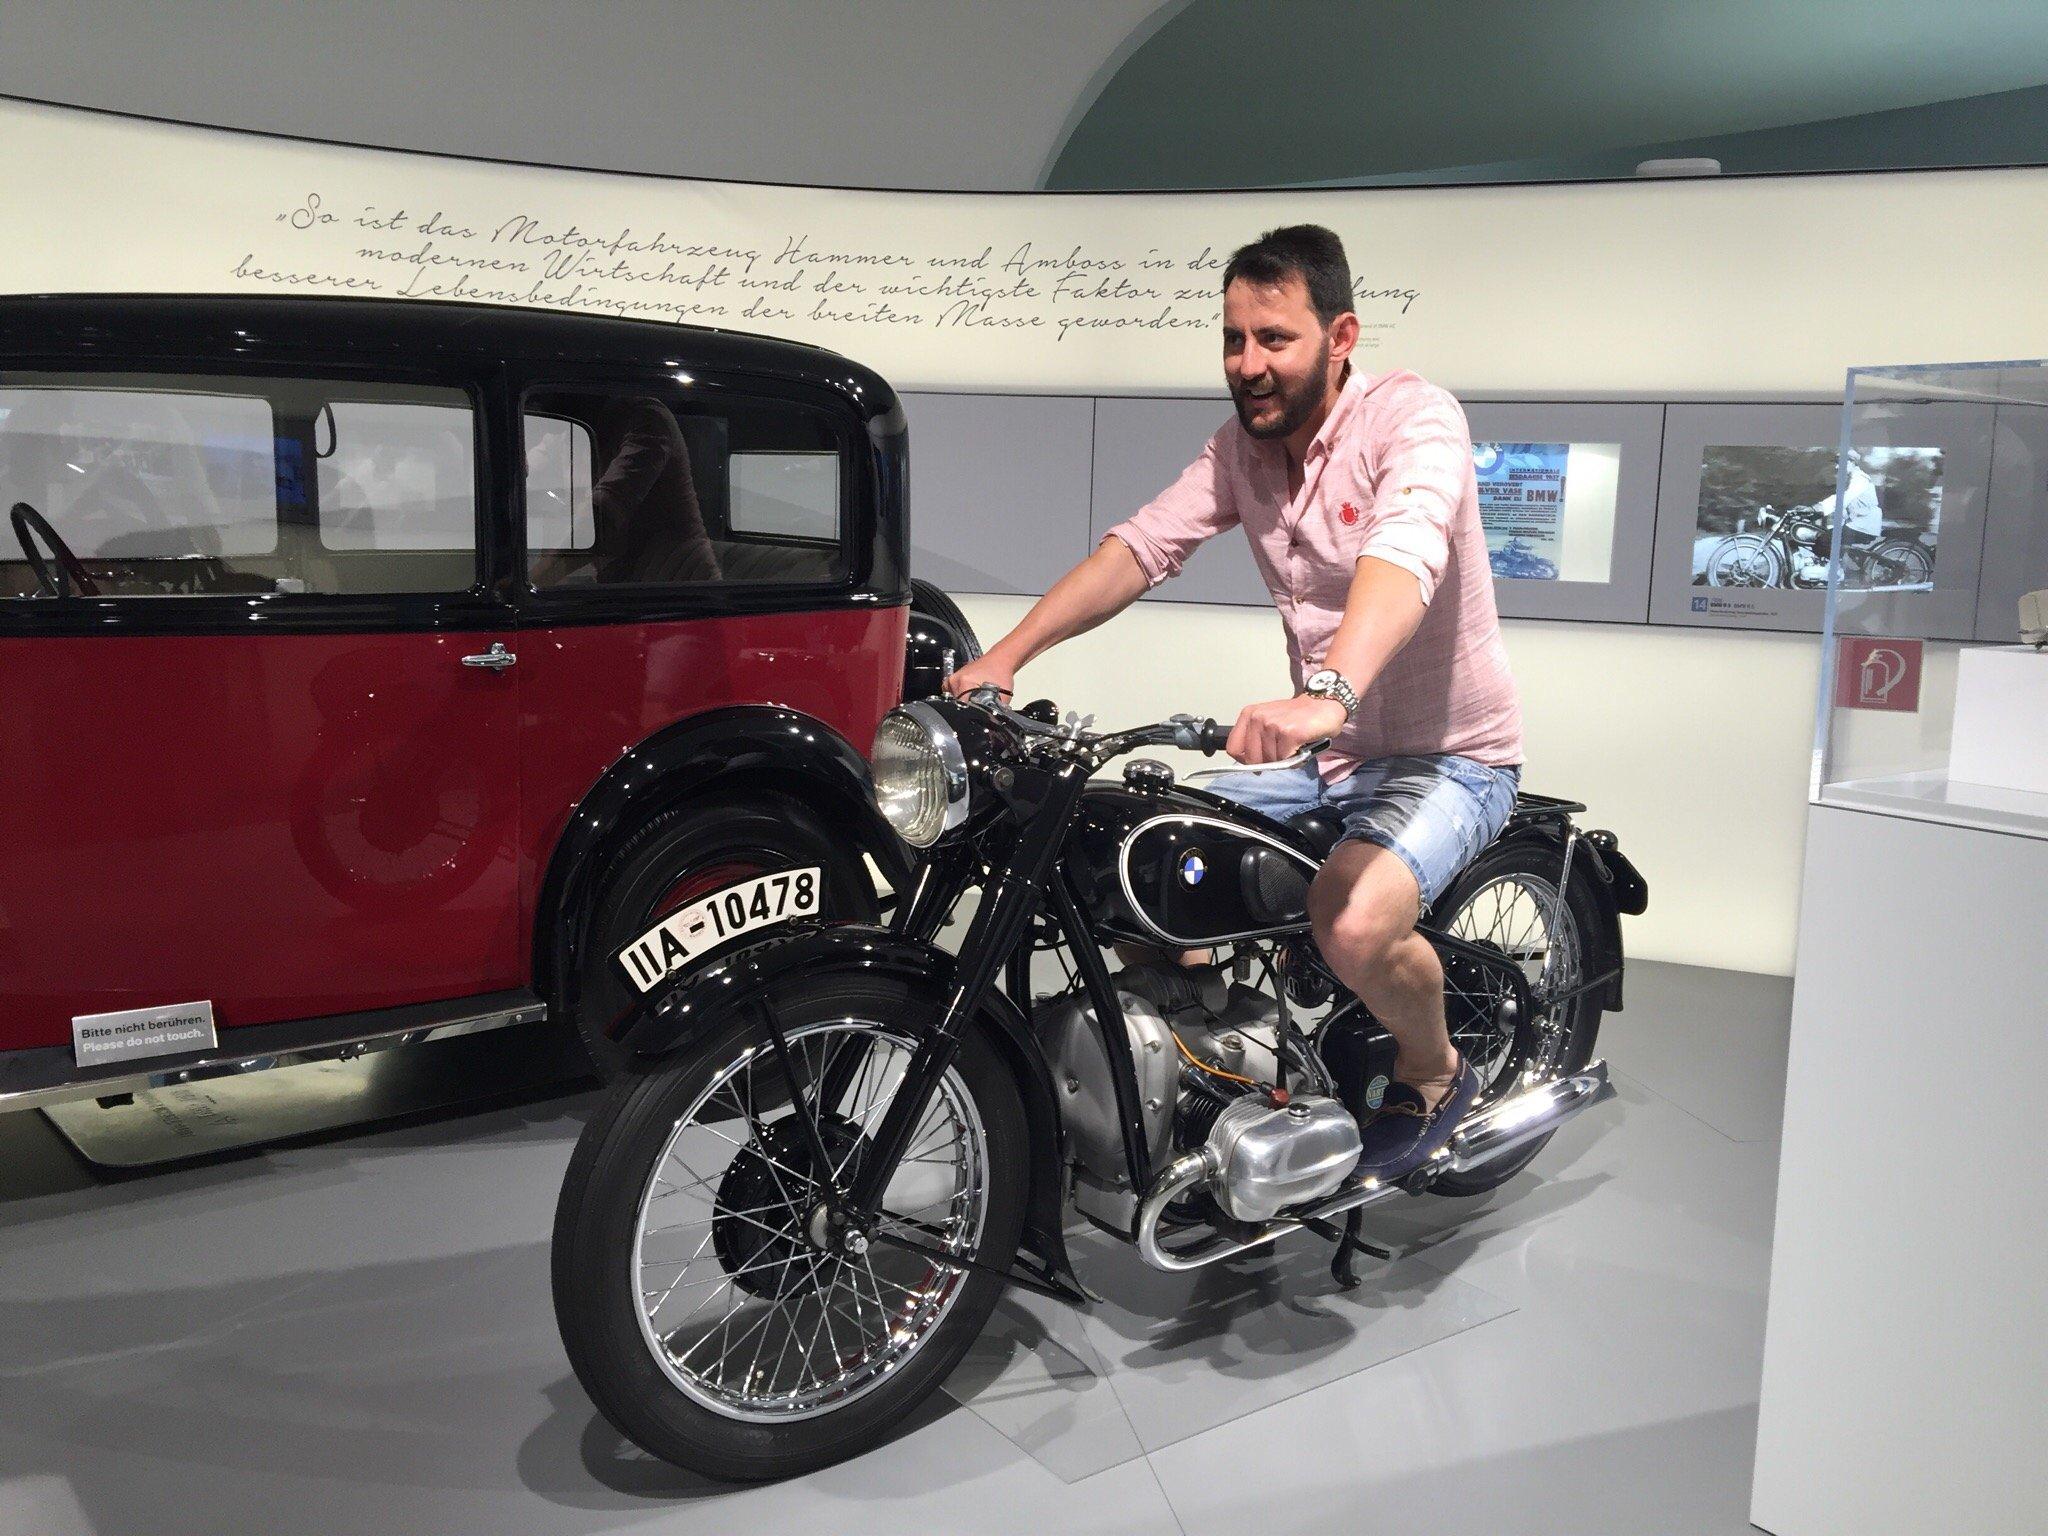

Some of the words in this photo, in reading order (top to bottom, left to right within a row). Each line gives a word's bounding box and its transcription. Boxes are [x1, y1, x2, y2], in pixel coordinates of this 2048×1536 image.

[353, 206, 408, 230] ist
[416, 211, 477, 238] das
[491, 215, 761, 273] Motorfahrzeug
[774, 235, 914, 266] Hammer
[927, 246, 992, 269] und
[1001, 241, 1126, 276] Amboss
[1139, 248, 1175, 270] in
[230, 253, 383, 290] besserer
[396, 265, 728, 323] Lebensbedingungen
[741, 296, 796, 319] der
[807, 302, 924, 325] breiten
[935, 299, 1046, 328] Masse
[356, 241, 529, 272] modernen
[543, 249, 730, 292] Wirtschaft
[738, 269, 802, 292] und
[813, 270, 867, 294] der
[879, 275, 1042, 312] wichtigste
[1052, 270, 1162, 303] Faktor
[81, 1028, 112, 1039] Bitte
[115, 1022, 146, 1035] nicht
[148, 1015, 206, 1030] berühren.
[82, 1040, 125, 1053] Please
[126, 1037, 143, 1047] do
[144, 1035, 166, 1045] not
[167, 1028, 205, 1042] touch.
